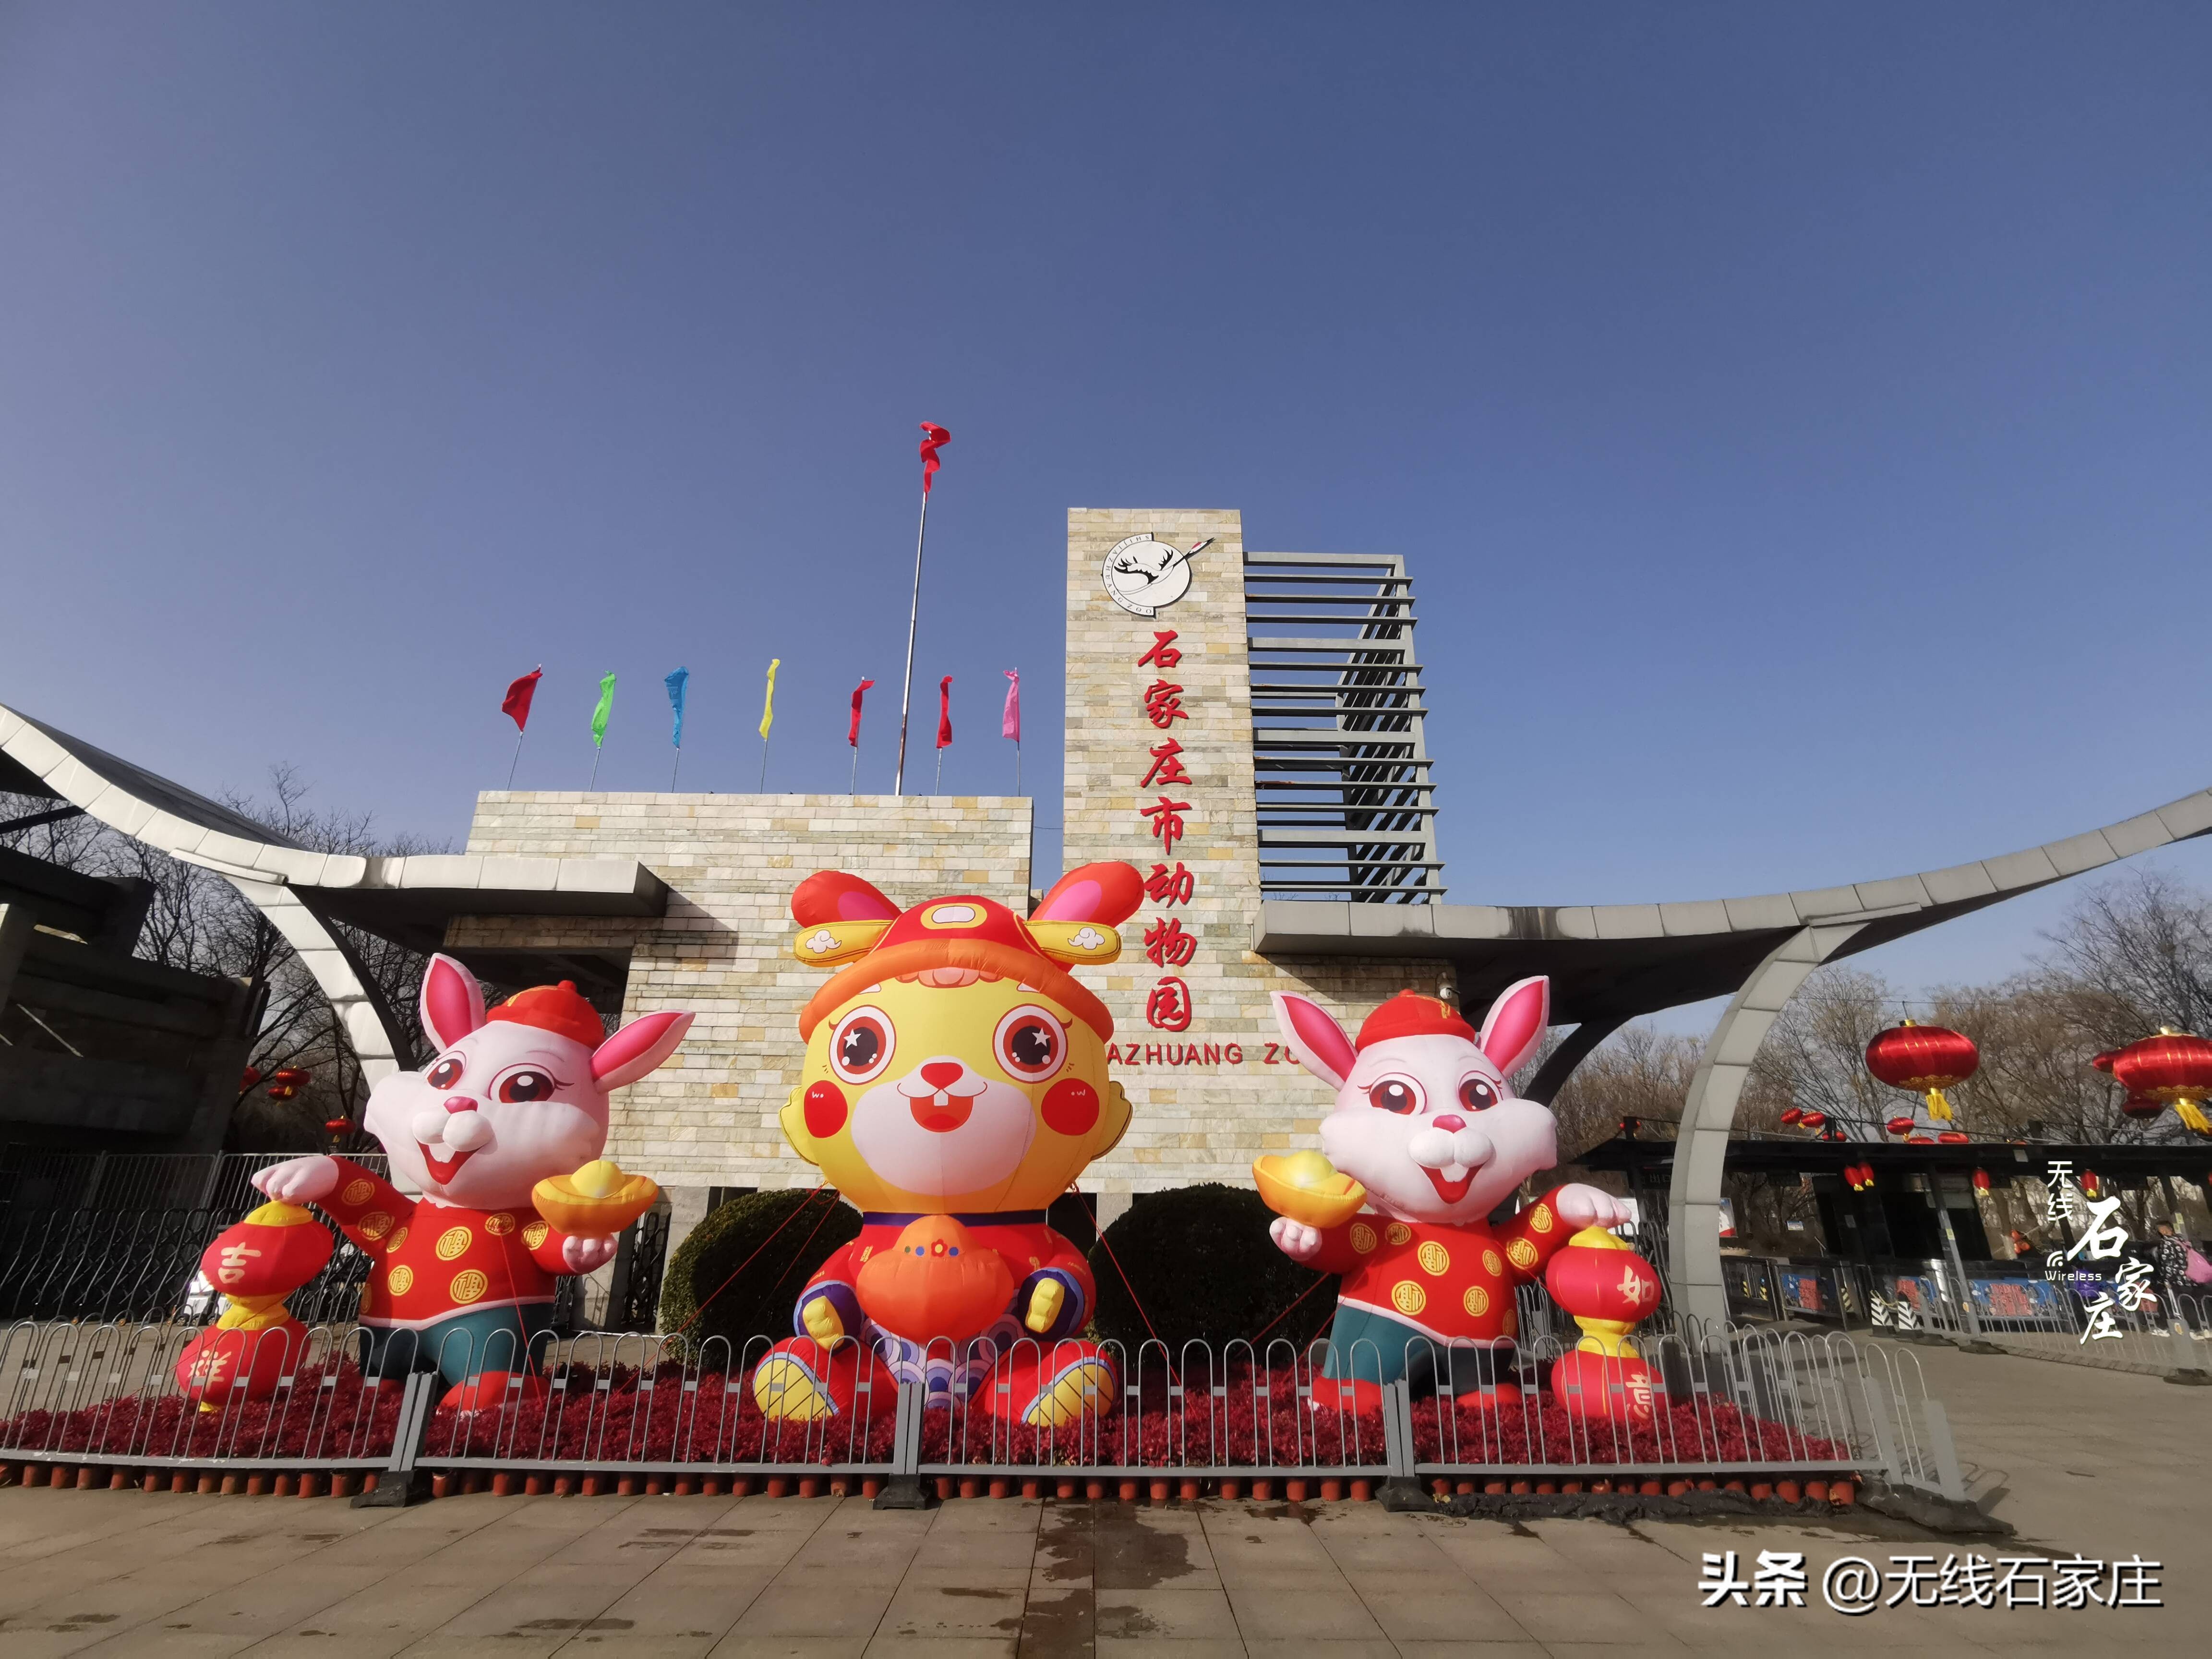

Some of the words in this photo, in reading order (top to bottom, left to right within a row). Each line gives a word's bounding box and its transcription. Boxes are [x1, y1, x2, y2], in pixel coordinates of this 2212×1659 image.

[1127, 603, 1152, 615] ZOO
[1138, 629, 1197, 1032] 石家庄市动物园
[218, 1242, 261, 1284] 吉
[438, 1229, 469, 1258] 福
[453, 1272, 485, 1301] 福
[1617, 1265, 1655, 1306] 如
[187, 1350, 231, 1390] 祥
